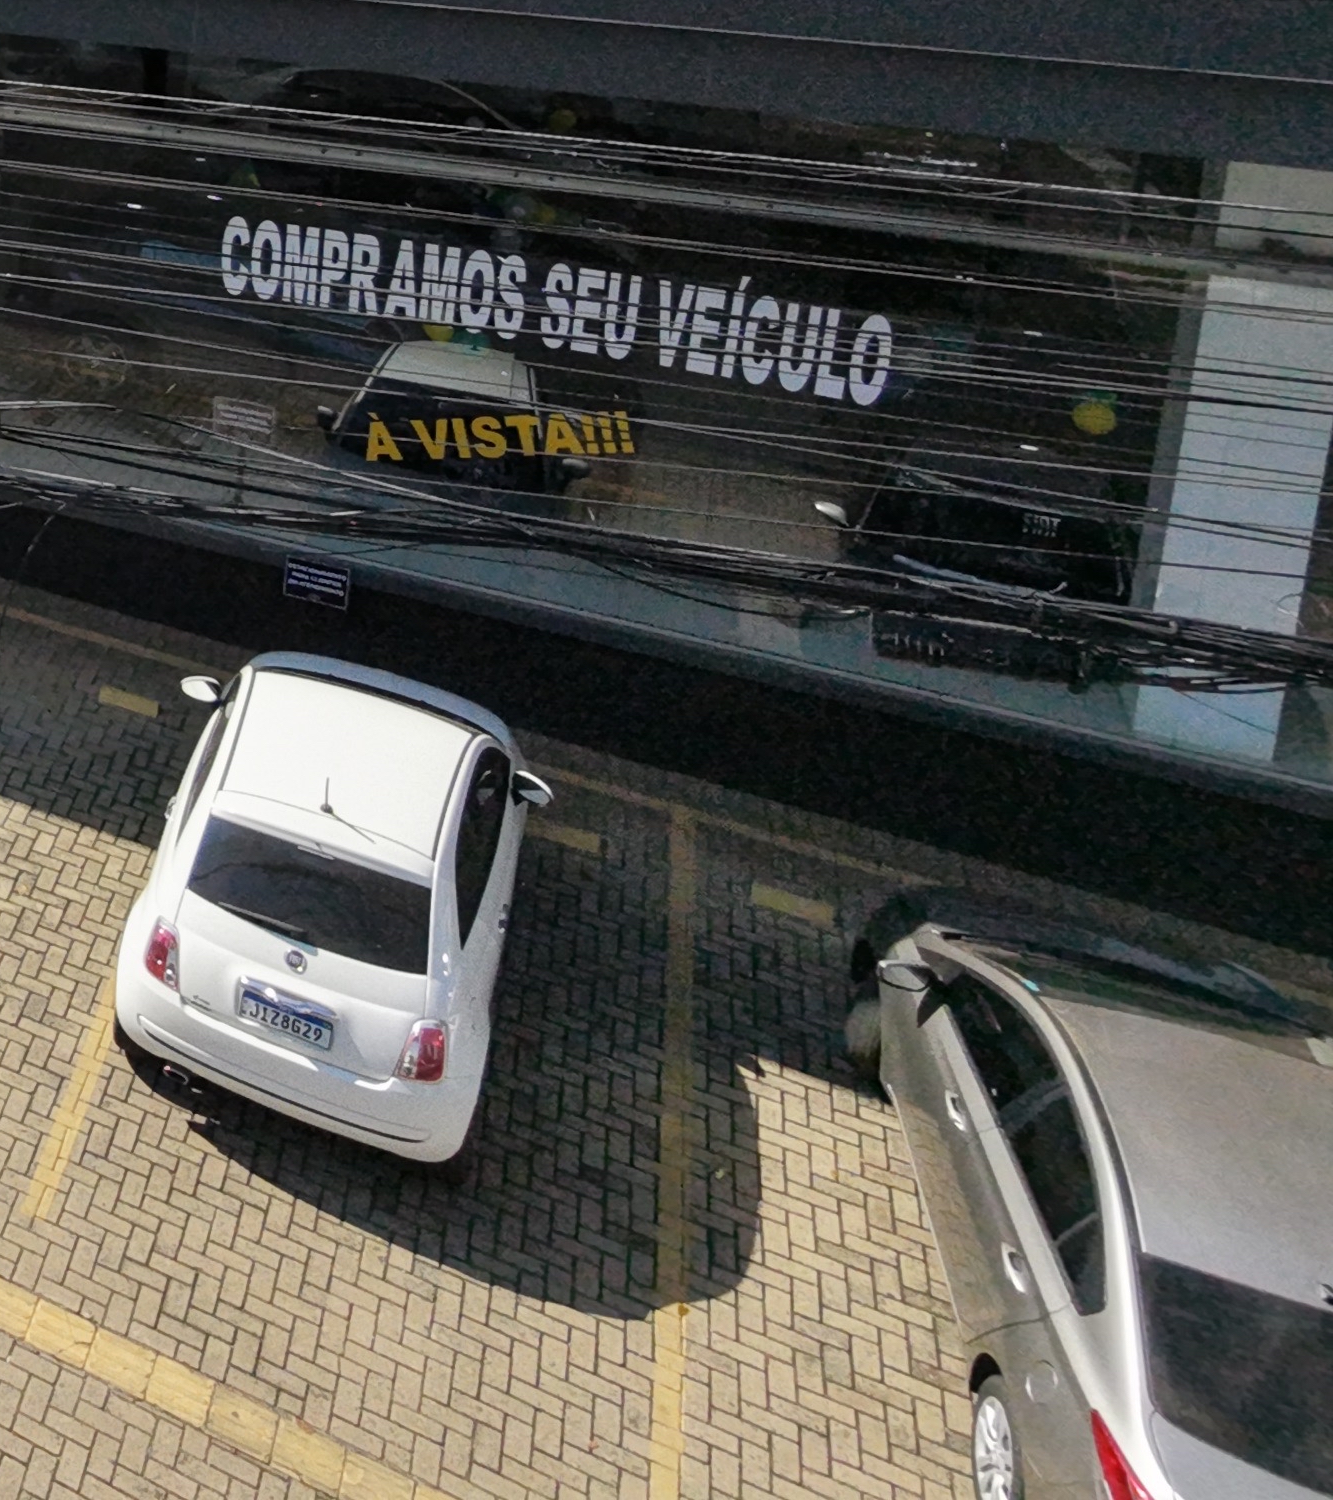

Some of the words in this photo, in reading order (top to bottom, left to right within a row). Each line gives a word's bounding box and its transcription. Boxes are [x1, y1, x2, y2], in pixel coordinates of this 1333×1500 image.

[221, 215, 527, 340] COMPRAMOS
[540, 262, 643, 361] SEU
[658, 275, 893, 407] VEÍCULO
[365, 411, 404, 462] À
[409, 410, 635, 461] VISTA!!!
[249, 1002, 324, 1043] JIZ8G29
